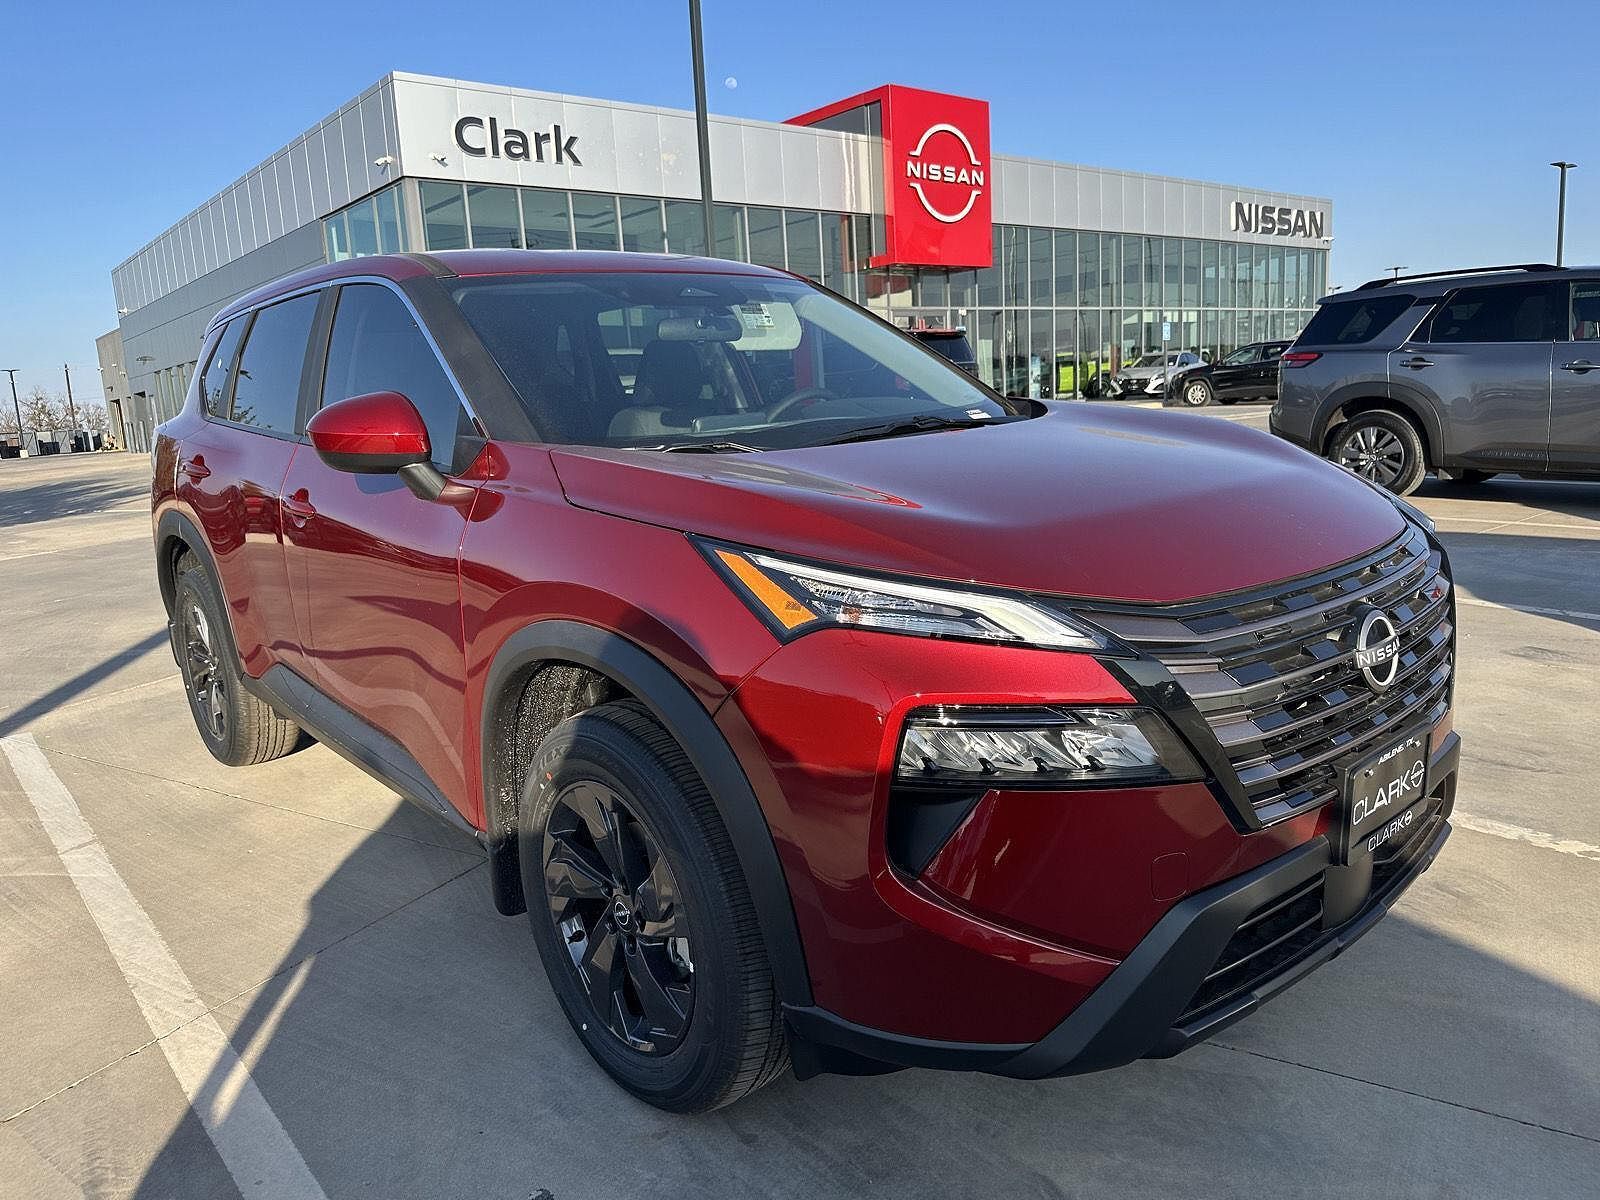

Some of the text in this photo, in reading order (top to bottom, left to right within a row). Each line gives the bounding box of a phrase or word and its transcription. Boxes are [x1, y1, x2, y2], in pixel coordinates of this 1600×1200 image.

[454, 116, 583, 166] Clark
[906, 160, 984, 187] NISSAN
[1232, 201, 1324, 239] NISSAN
[1352, 769, 1411, 826] CLARK
[1367, 816, 1408, 852] CLARK
